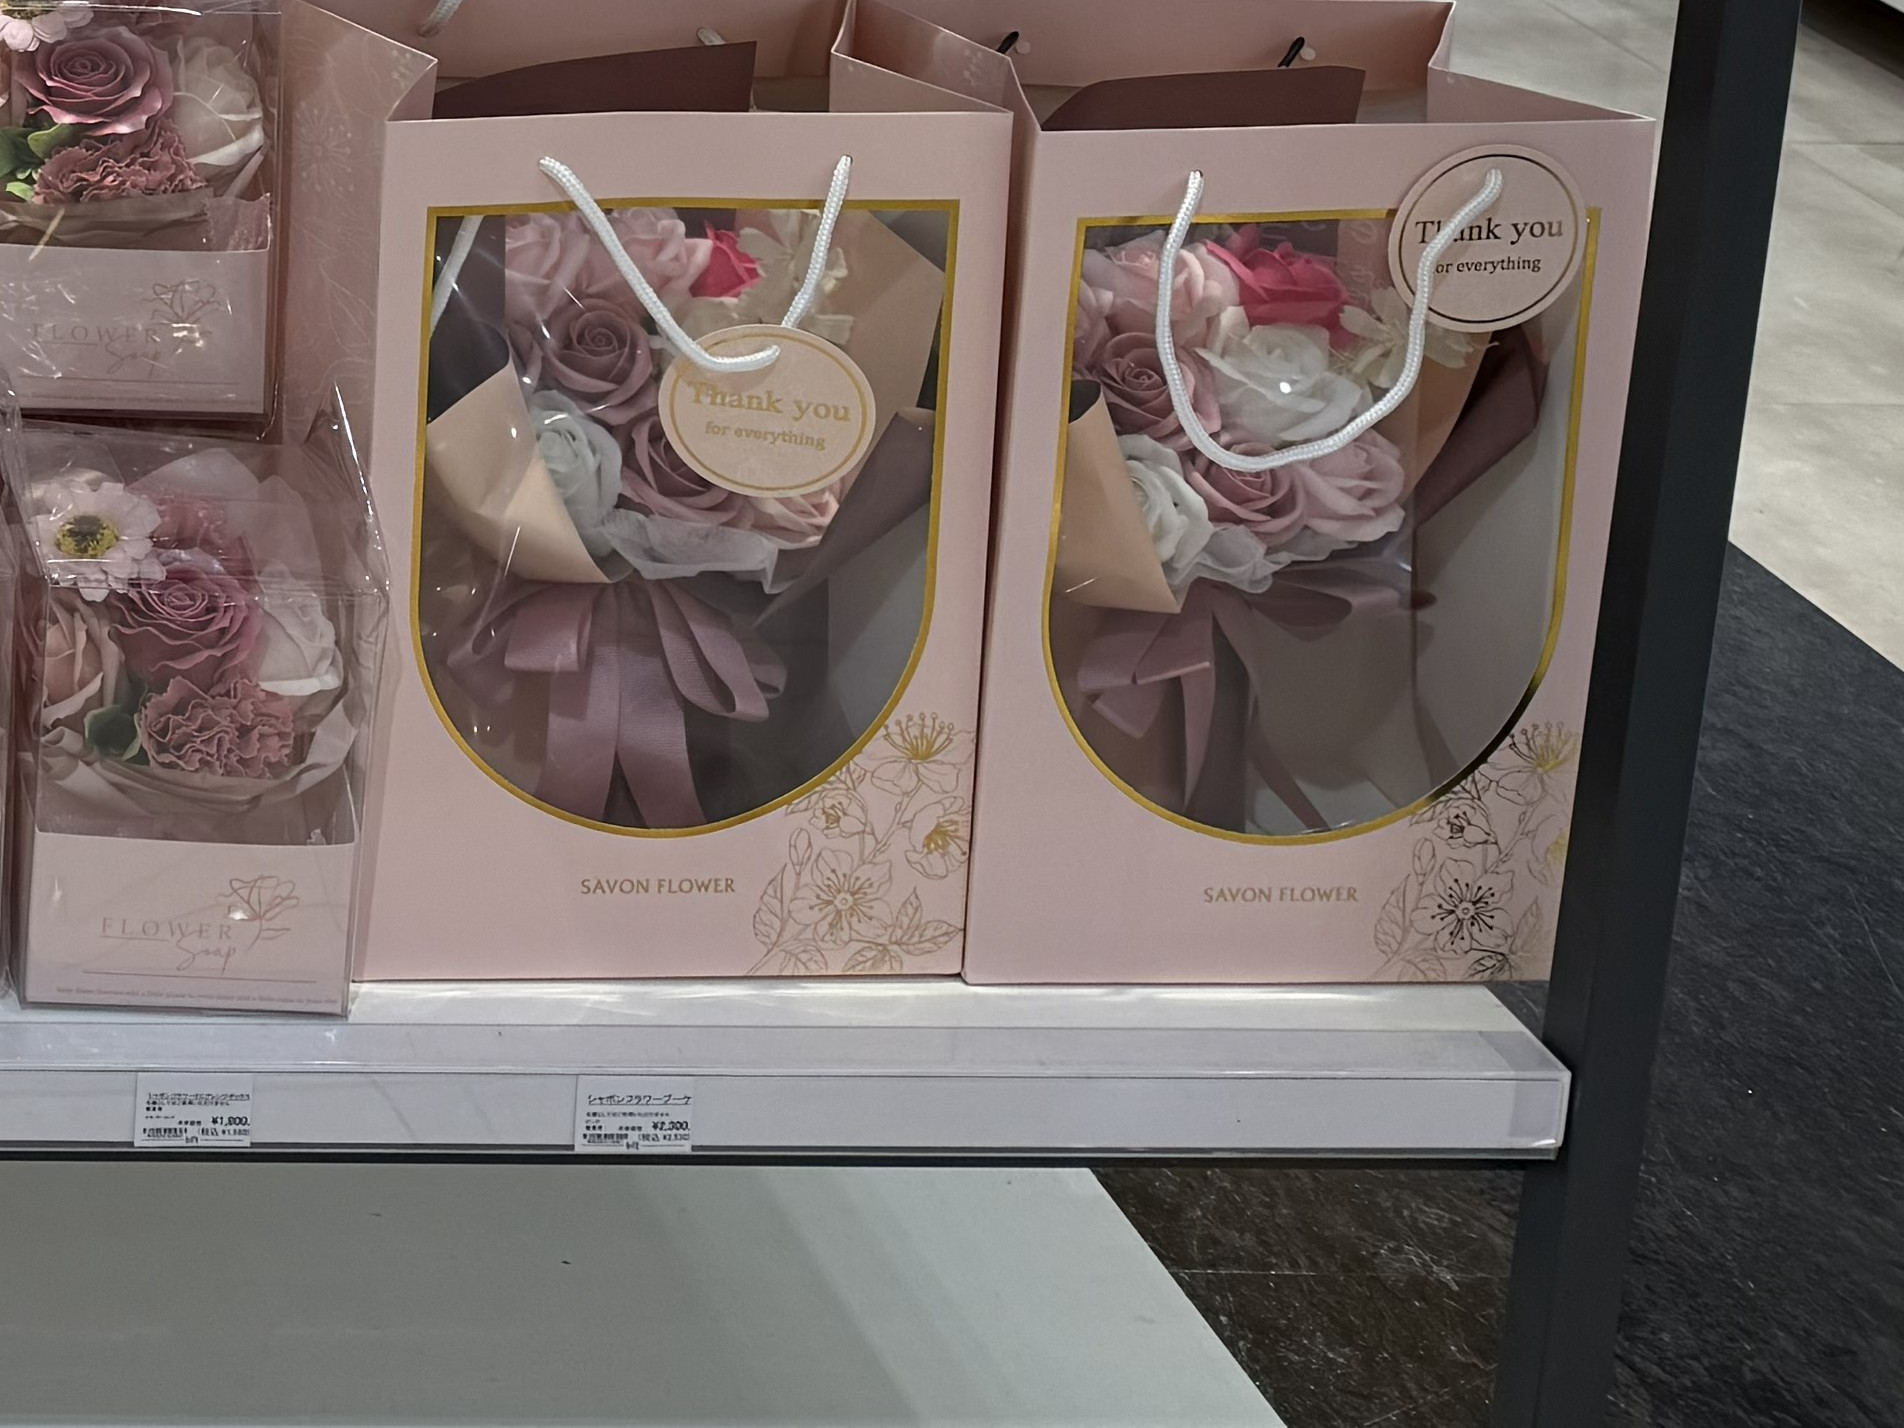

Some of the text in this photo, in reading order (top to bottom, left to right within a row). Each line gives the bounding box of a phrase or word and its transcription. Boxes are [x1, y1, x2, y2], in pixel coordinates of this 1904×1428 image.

[1511, 220, 1564, 246] you
[1456, 257, 1543, 274] everything
[691, 380, 852, 425] Thank you
[705, 421, 826, 452] for everything
[579, 876, 736, 895] SAVON FLOWER
[1203, 885, 1360, 904] SAVON FLOWER
[101, 918, 233, 941] FLOWER
